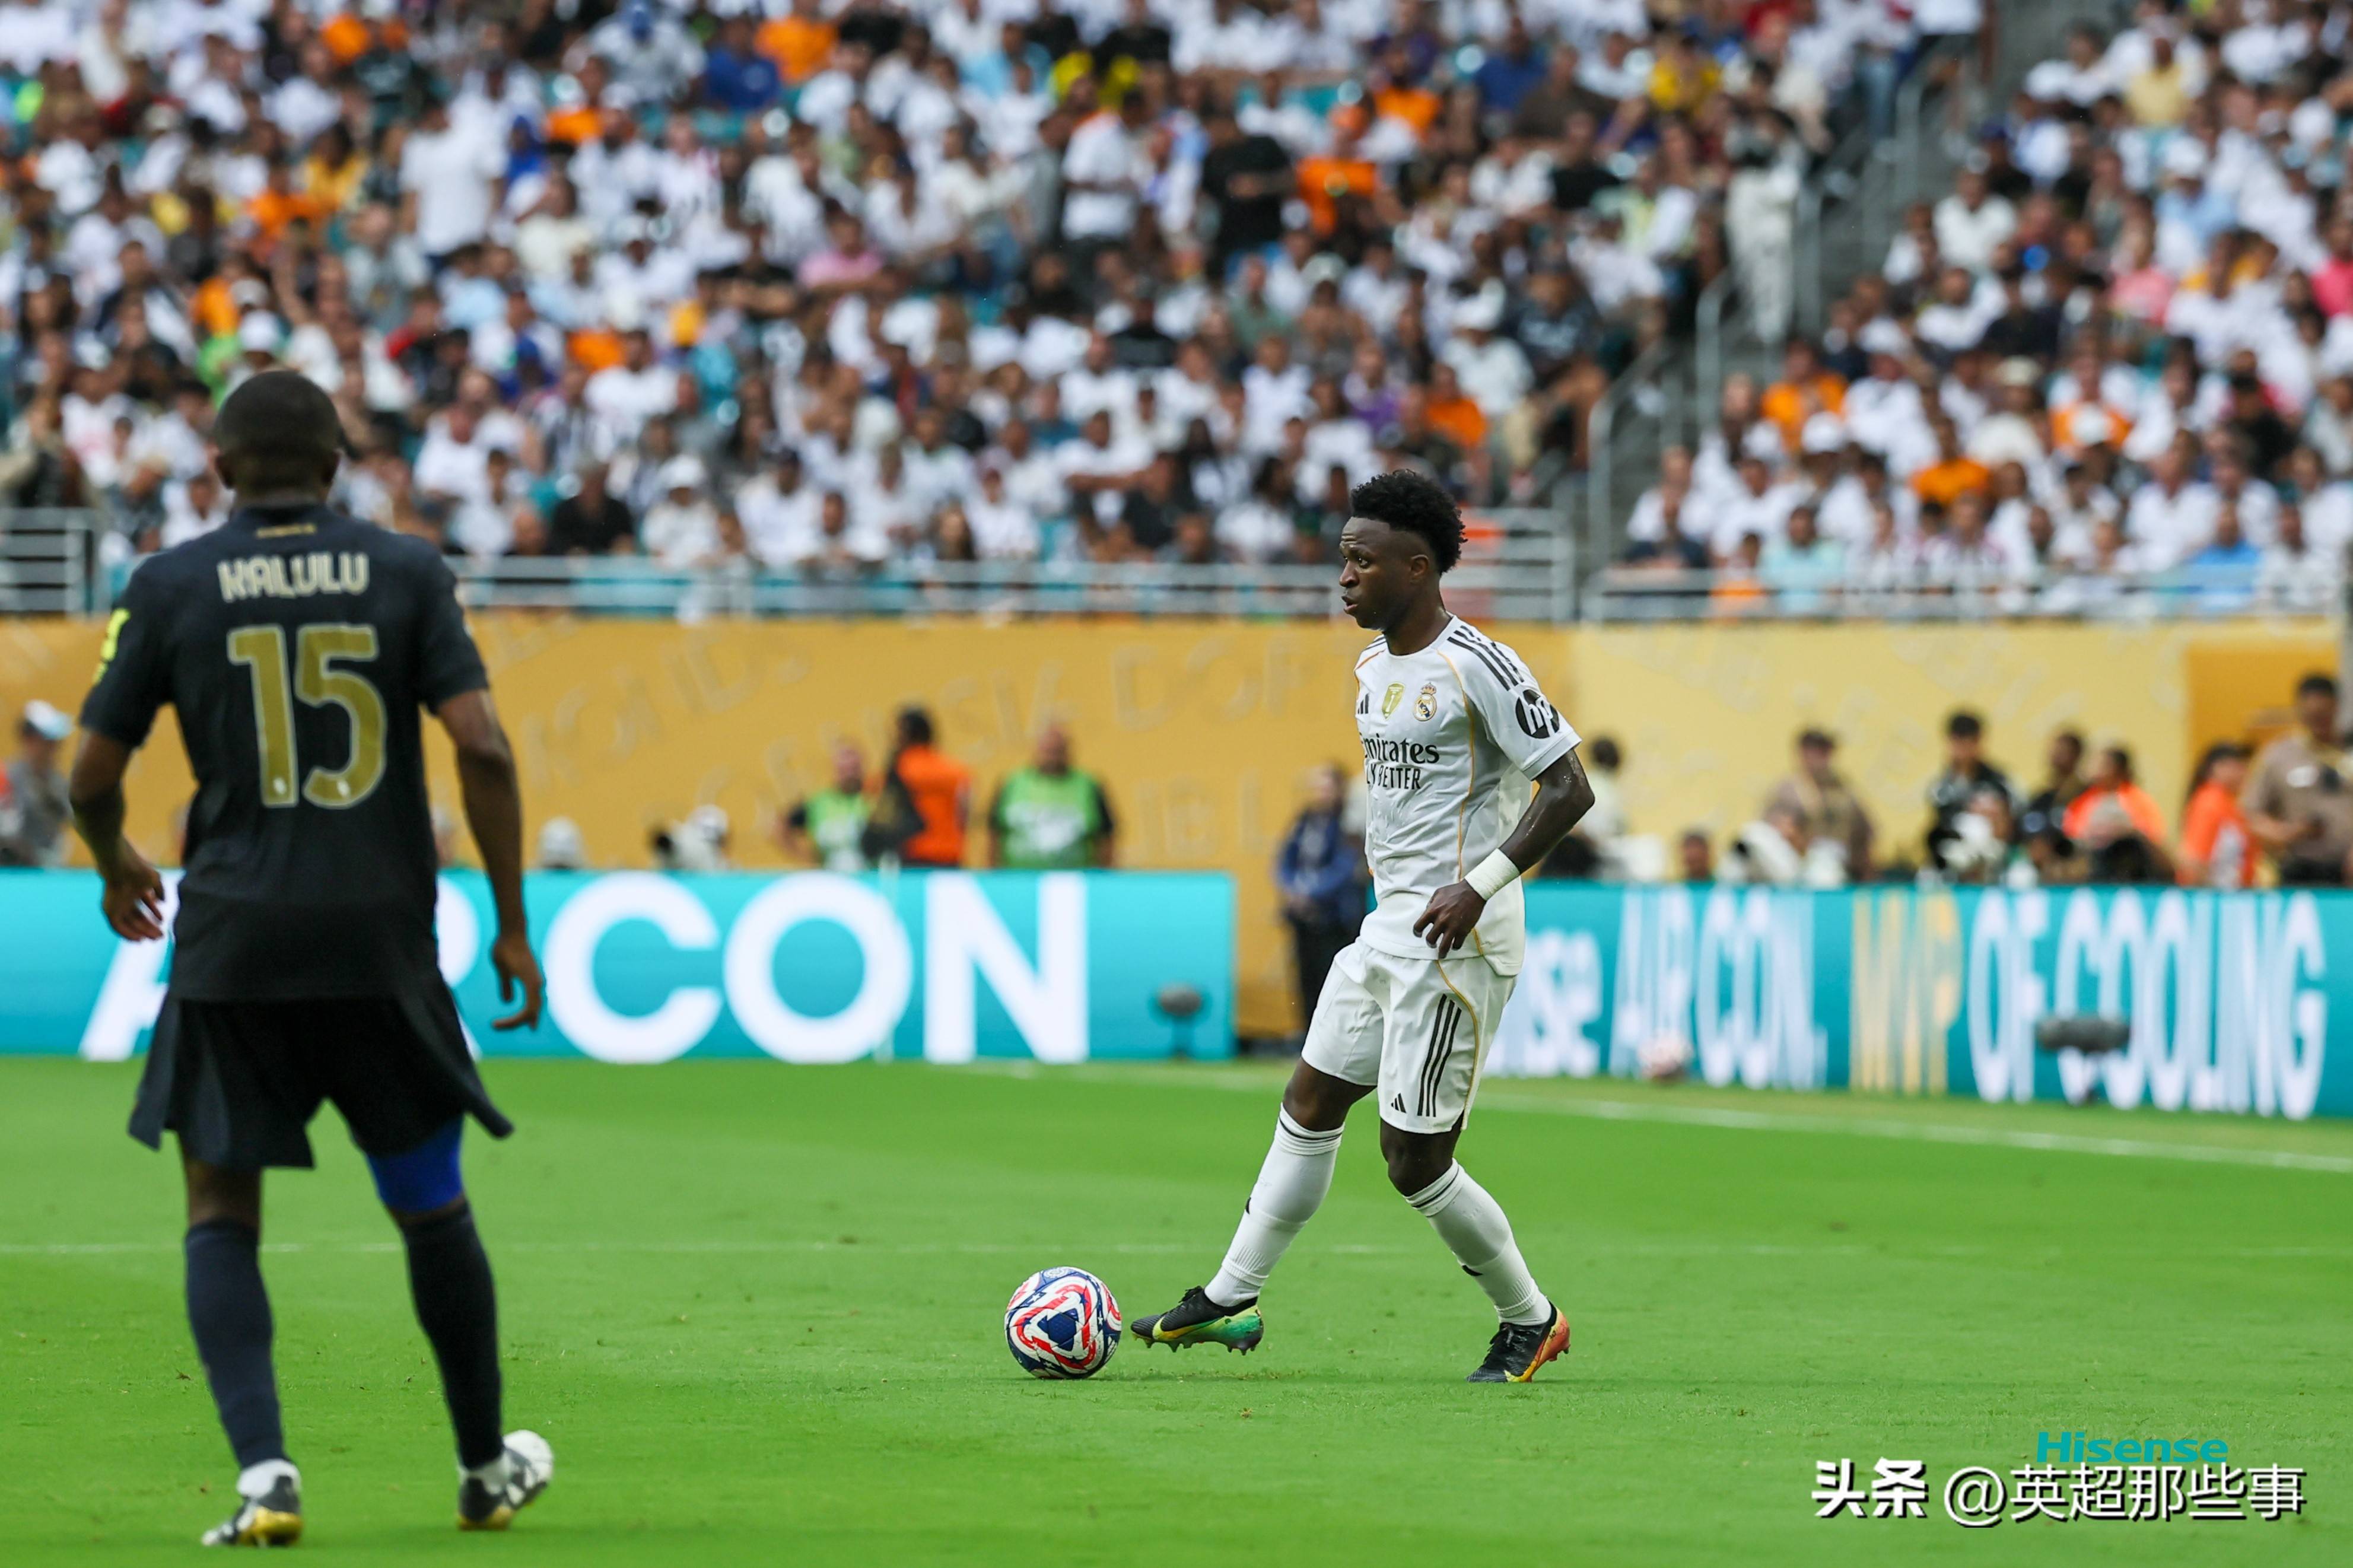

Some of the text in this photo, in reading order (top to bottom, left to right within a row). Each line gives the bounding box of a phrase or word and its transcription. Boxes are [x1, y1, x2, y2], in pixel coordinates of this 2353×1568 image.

[217, 551, 370, 603] KALULU
[227, 623, 387, 809] 15
[1517, 691, 1556, 737] hp
[1359, 732, 1440, 764] mirates
[1378, 765, 1422, 790] BETTER
[542, 870, 1089, 1064] CON
[1967, 887, 2049, 1105] OF
[2054, 886, 2329, 1121] COOLING
